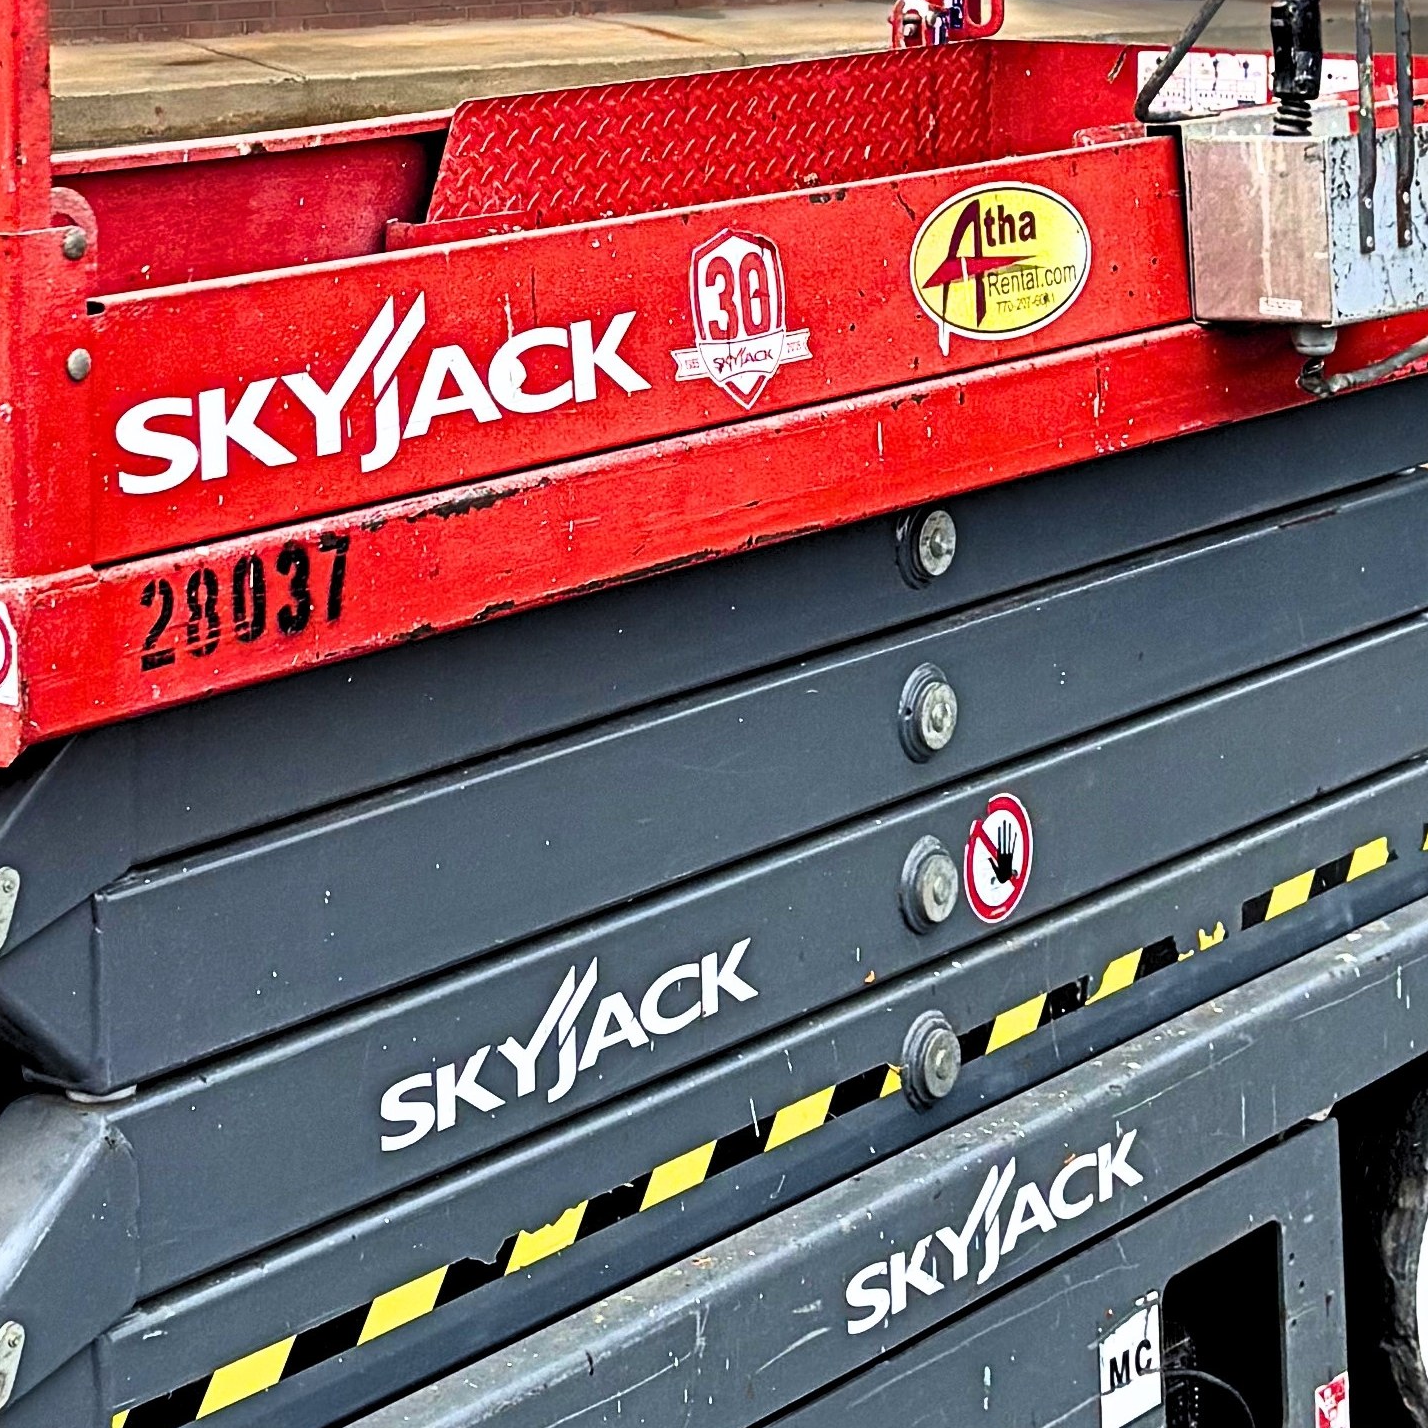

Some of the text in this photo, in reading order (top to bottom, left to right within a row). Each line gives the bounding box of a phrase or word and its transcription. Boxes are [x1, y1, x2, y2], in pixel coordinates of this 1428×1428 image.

[987, 263, 1077, 298] Rental.com
[116, 292, 652, 495] SKYJACK
[141, 533, 351, 671] 28037
[380, 937, 759, 1152] SKYJACK
[845, 1128, 1145, 1335] SKYJACK
[1109, 1338, 1153, 1390] MC
